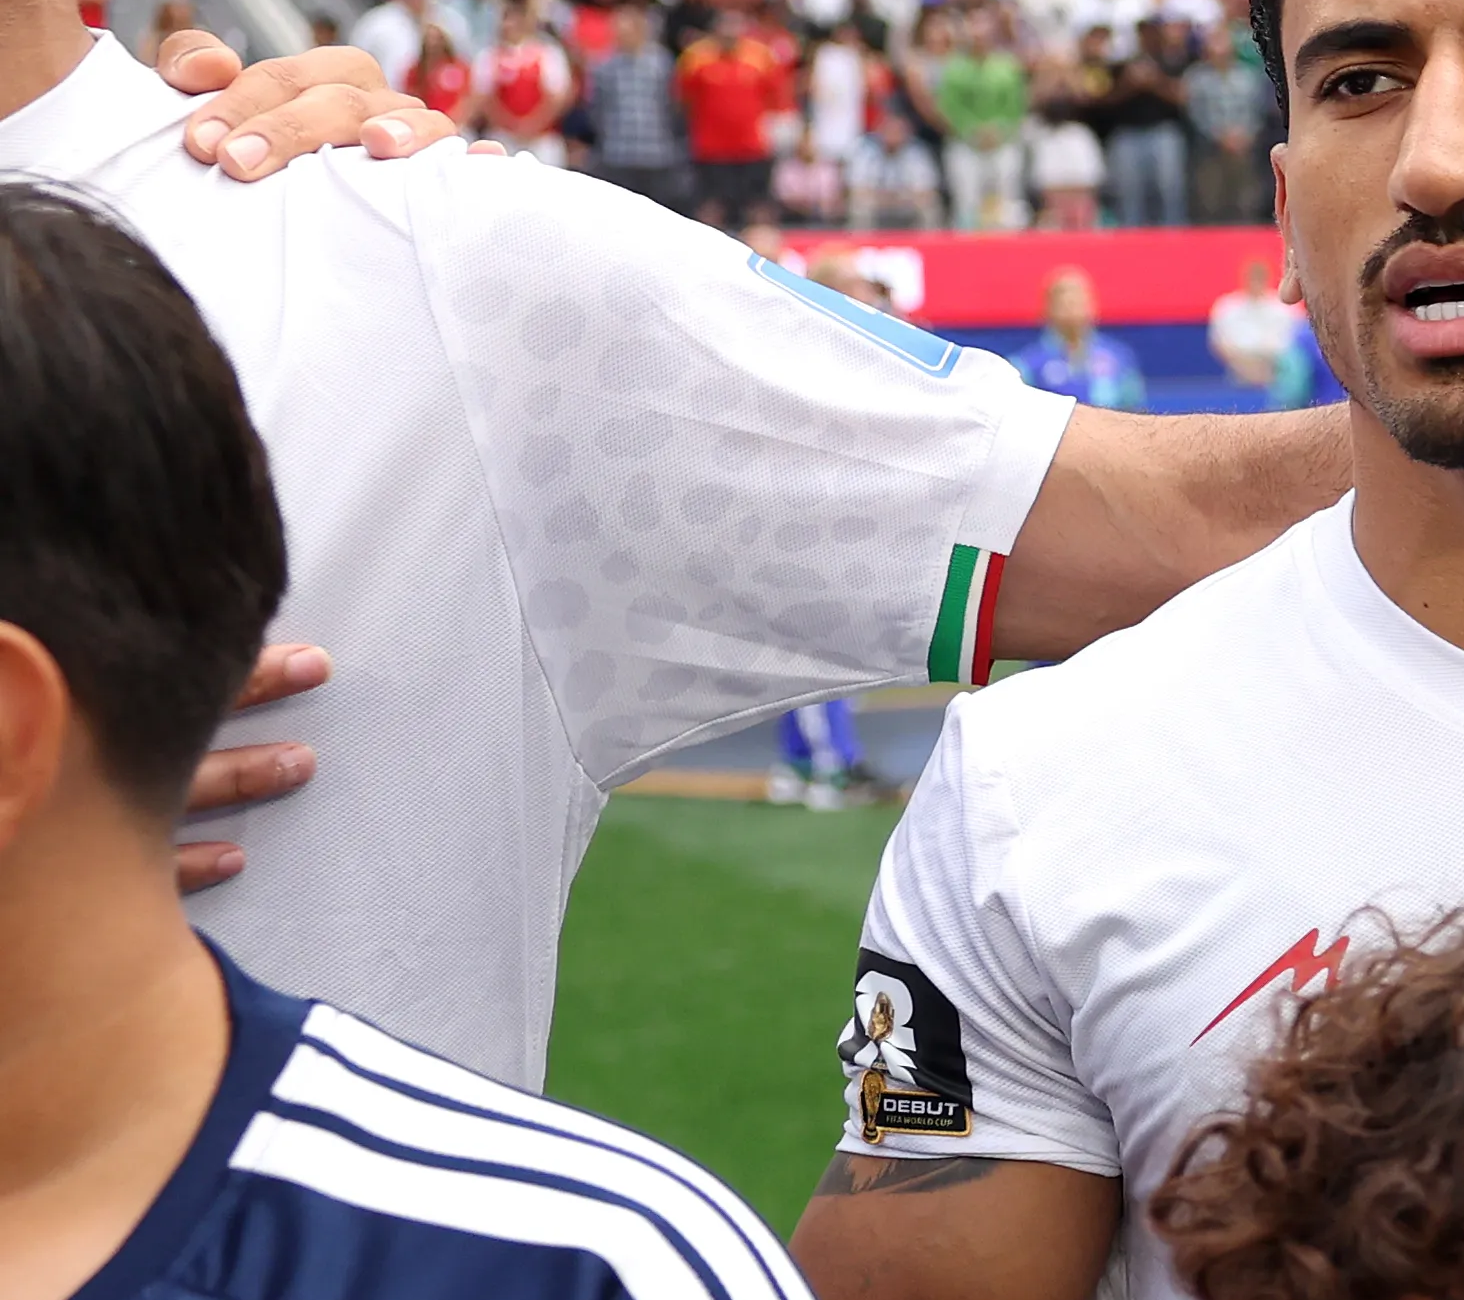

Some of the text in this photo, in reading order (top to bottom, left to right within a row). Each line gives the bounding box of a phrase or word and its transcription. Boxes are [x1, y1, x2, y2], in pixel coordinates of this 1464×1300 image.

[883, 1098, 959, 1116] DEBUT
[886, 1115, 954, 1127] FIFA WORLD CUP
